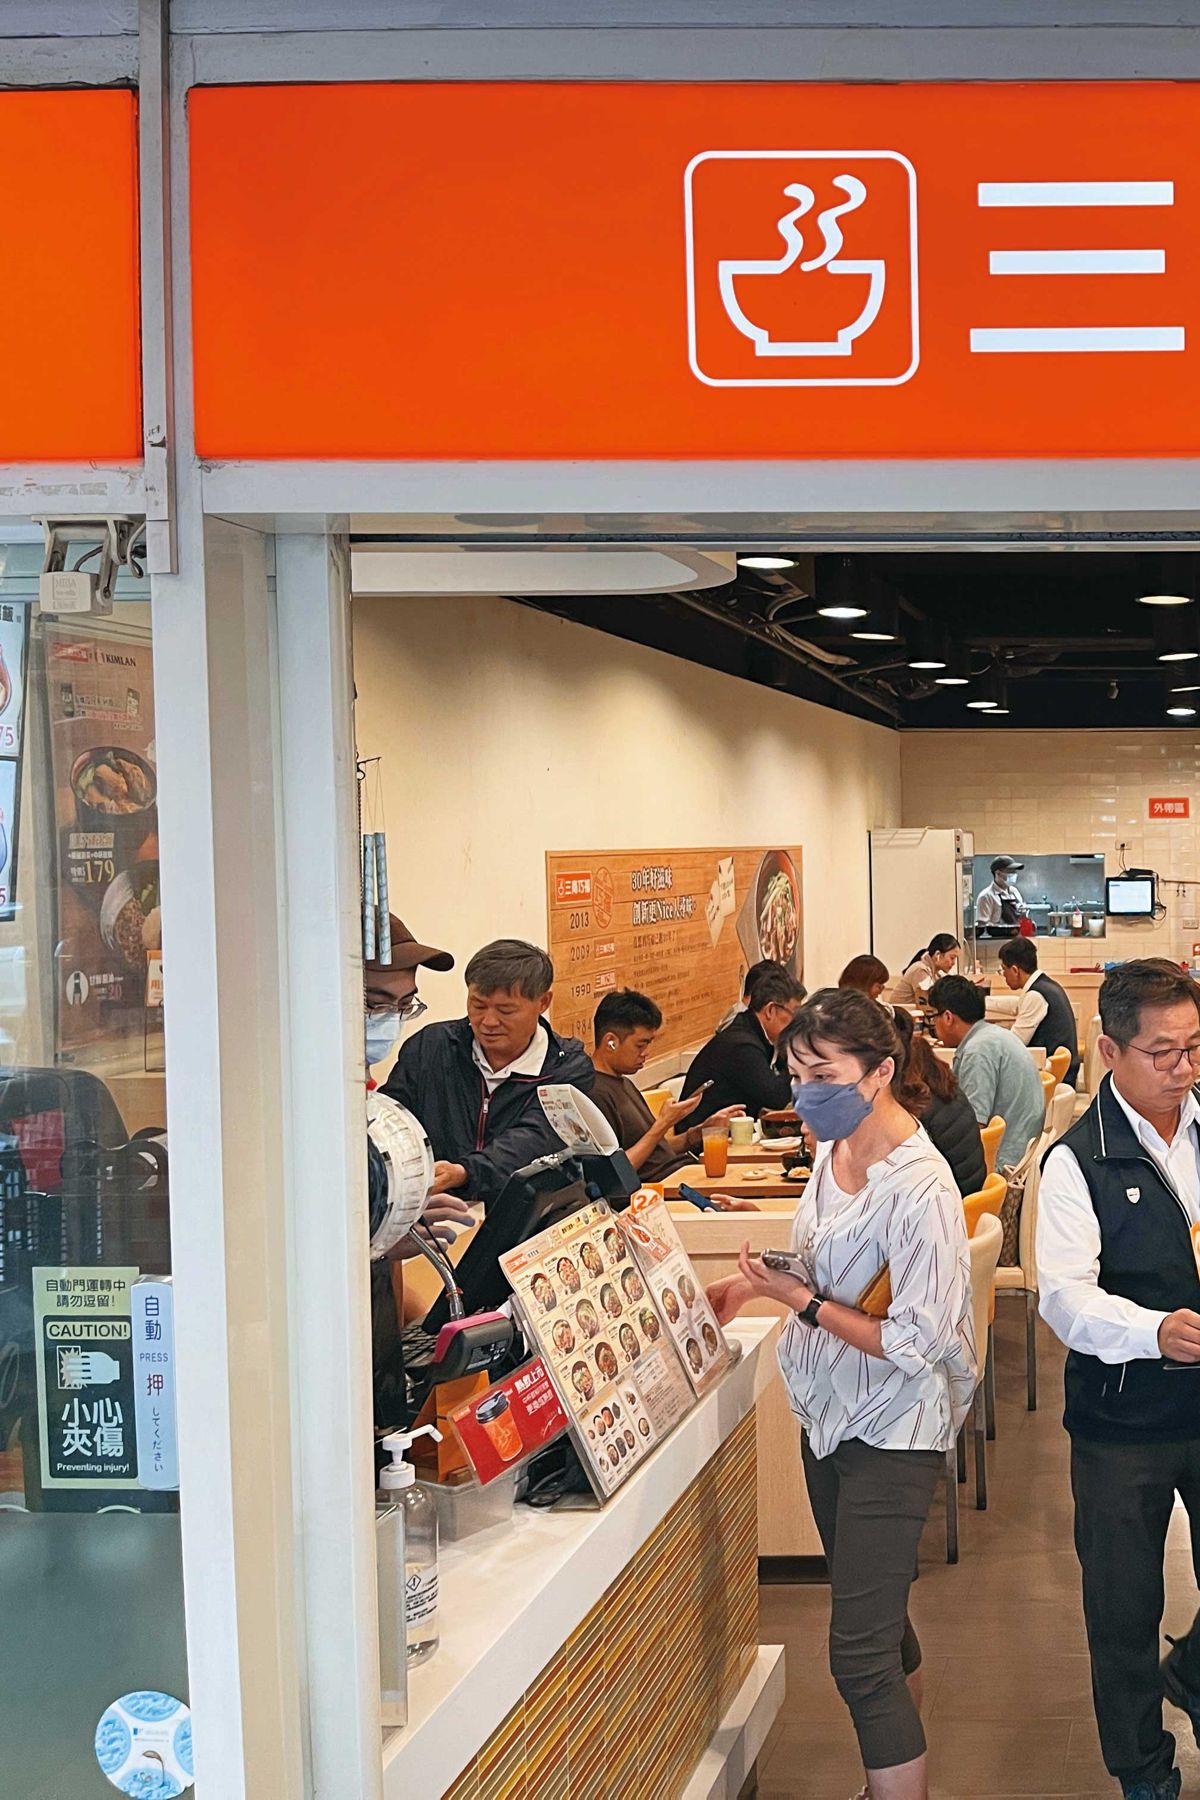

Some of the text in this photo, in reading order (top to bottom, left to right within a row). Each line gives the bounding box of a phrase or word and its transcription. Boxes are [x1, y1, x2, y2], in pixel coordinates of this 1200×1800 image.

[106, 652, 137, 667] KIMLAN
[85, 860, 115, 884] 179
[570, 912, 590, 929] 2013
[571, 945, 590, 962] 2009
[571, 983, 591, 998] 1990
[46, 1279, 126, 1293] 自動門運轉中
[145, 1296, 162, 1342] 自動
[49, 1324, 127, 1338] CAUTION!
[140, 1352, 168, 1363] PRESS
[147, 1374, 164, 1397] 押
[61, 1397, 124, 1428] 小心
[62, 1426, 124, 1458] 夾傷
[57, 1462, 130, 1474] Preventing injury!
